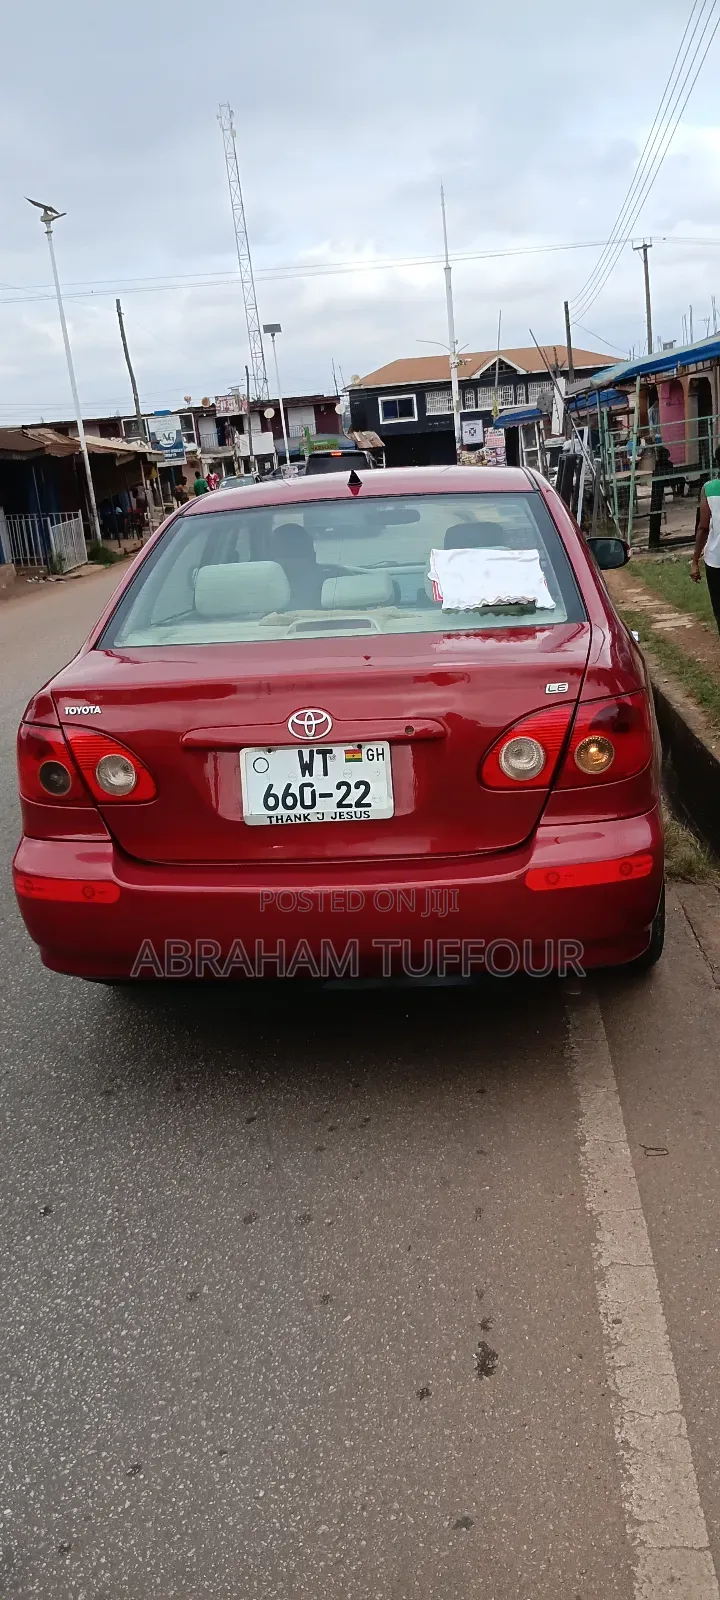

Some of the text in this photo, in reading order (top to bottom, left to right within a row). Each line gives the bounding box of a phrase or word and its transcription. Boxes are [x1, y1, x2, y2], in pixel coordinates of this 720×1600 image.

[547, 683, 567, 692] LE
[64, 705, 102, 715] TOYOTA
[366, 748, 385, 762] GH
[298, 748, 333, 778] WT
[263, 780, 372, 811] 660-22
[267, 813, 312, 825] THANK
[330, 810, 371, 820] JESUS
